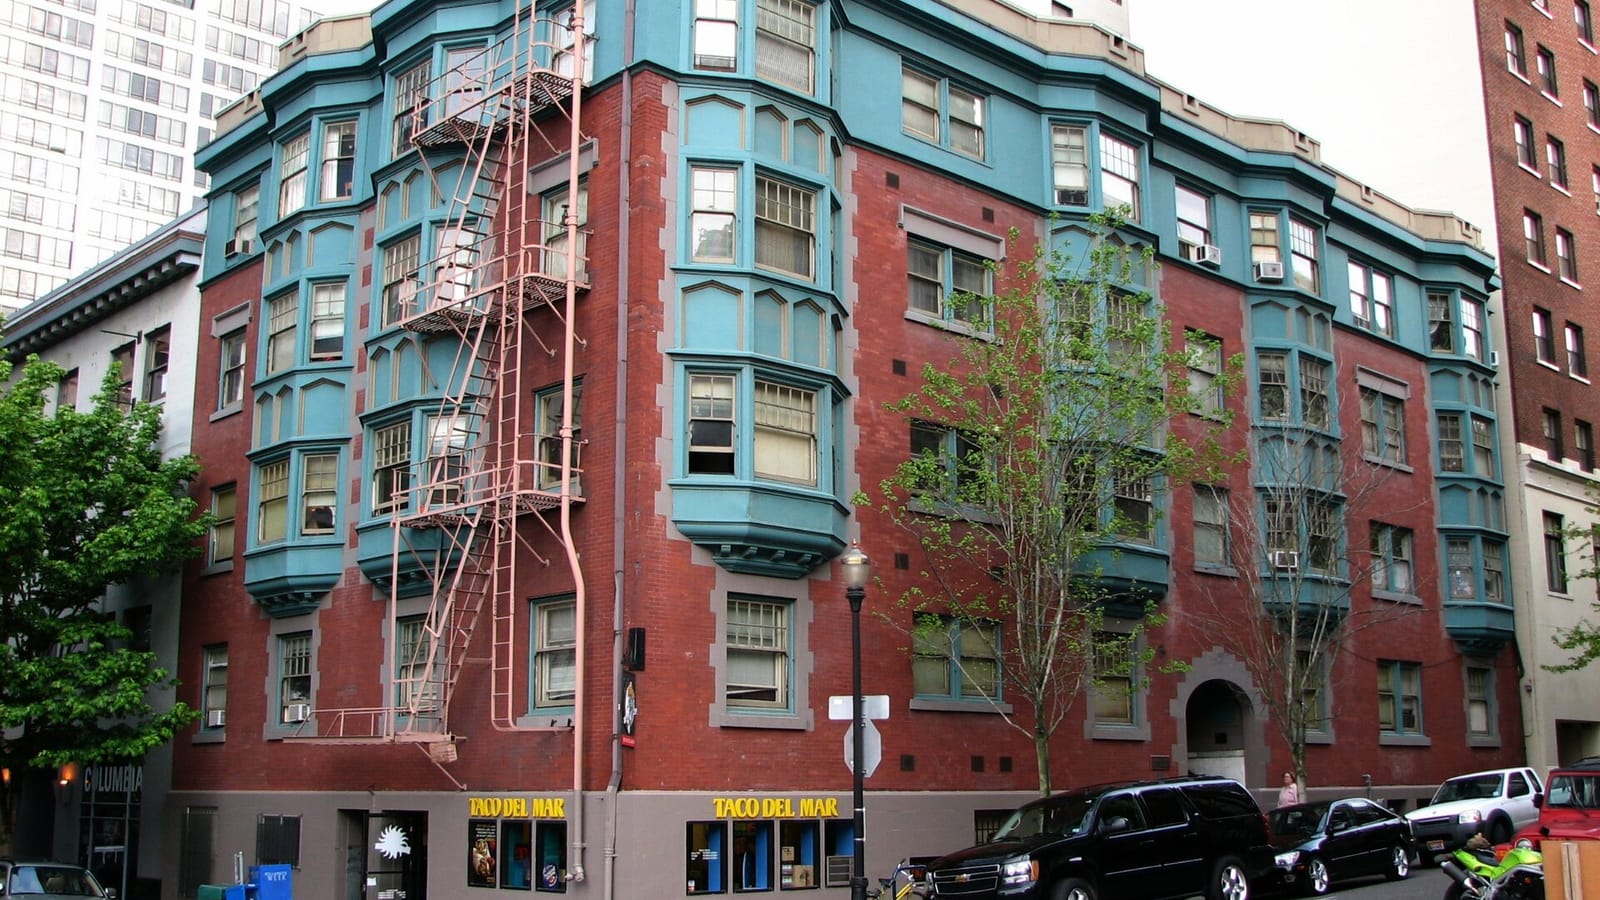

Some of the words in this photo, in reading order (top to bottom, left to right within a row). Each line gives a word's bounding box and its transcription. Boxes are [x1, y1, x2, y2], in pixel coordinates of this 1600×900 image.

[469, 797, 502, 817] TACO
[503, 798, 528, 817] DEL
[532, 798, 565, 818] MAR
[713, 797, 760, 818] TACO
[762, 798, 795, 818] DEL
[800, 798, 838, 818] MAR
